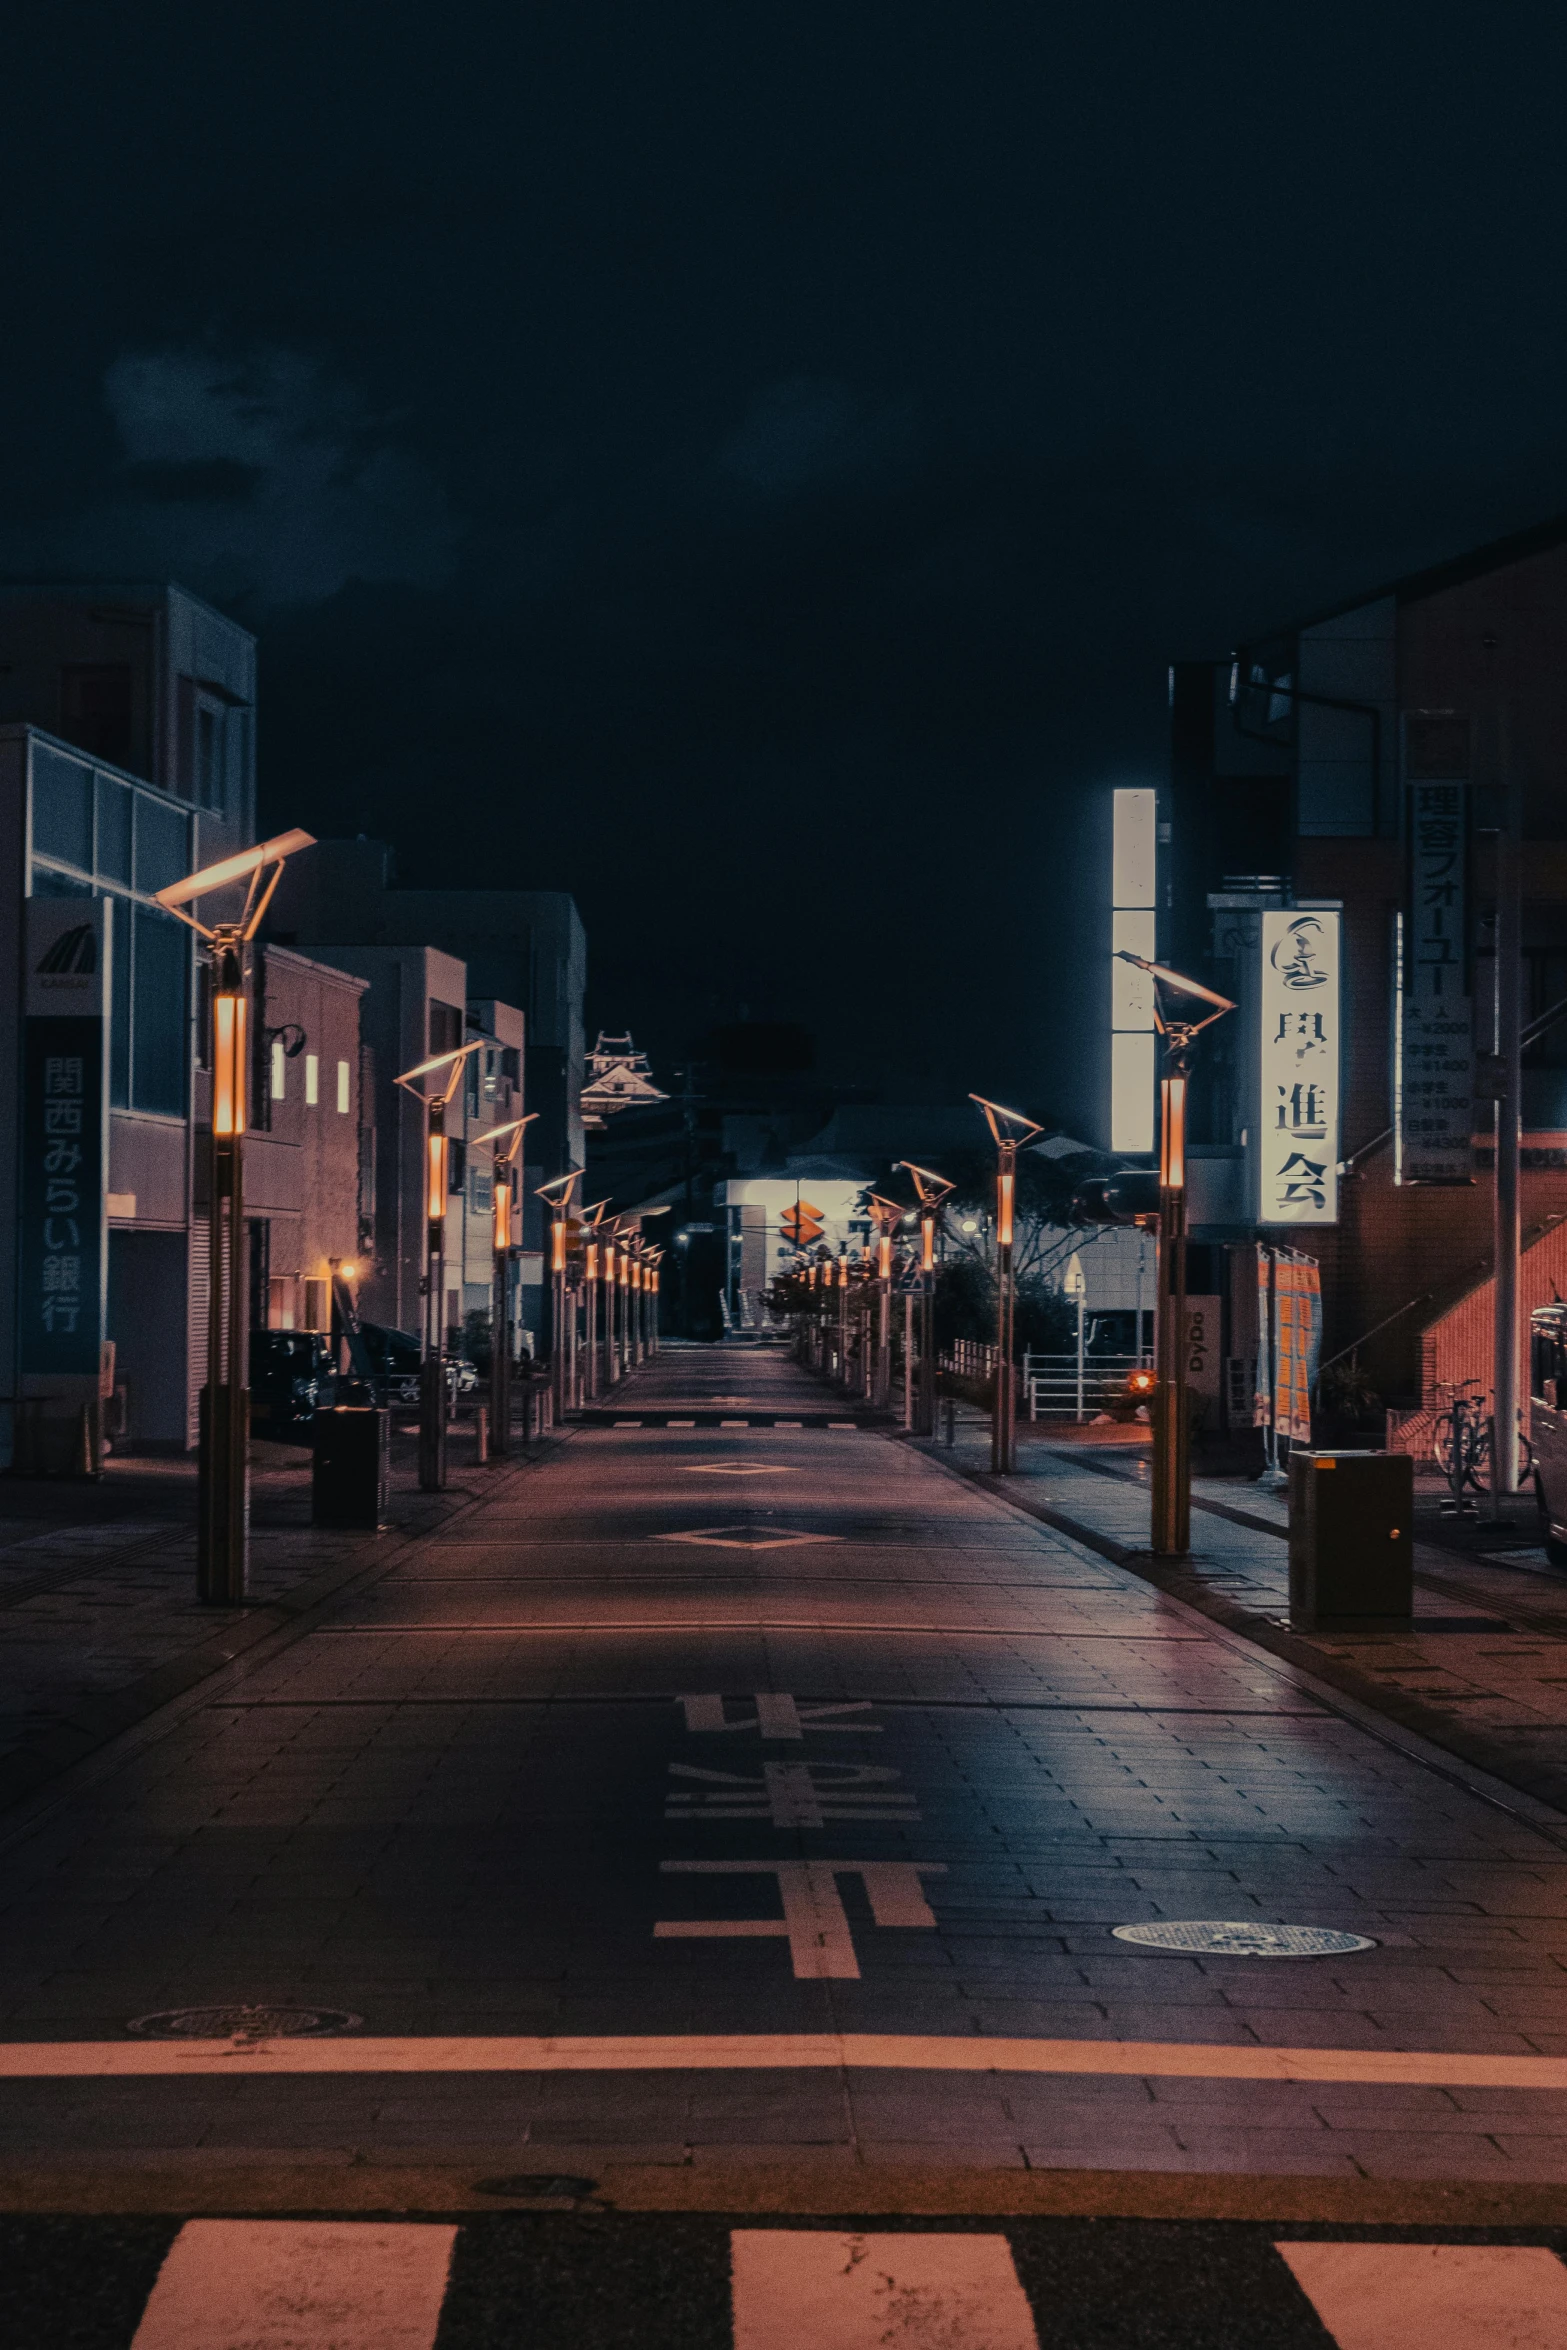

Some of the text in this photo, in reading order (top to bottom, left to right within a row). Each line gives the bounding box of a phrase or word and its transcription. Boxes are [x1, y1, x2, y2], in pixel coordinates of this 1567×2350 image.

[1418, 786, 1460, 996] 理容フォーユー
[41, 1056, 85, 1333] 関西みらい銀行
[1189, 1311, 1209, 1372] DyDo
